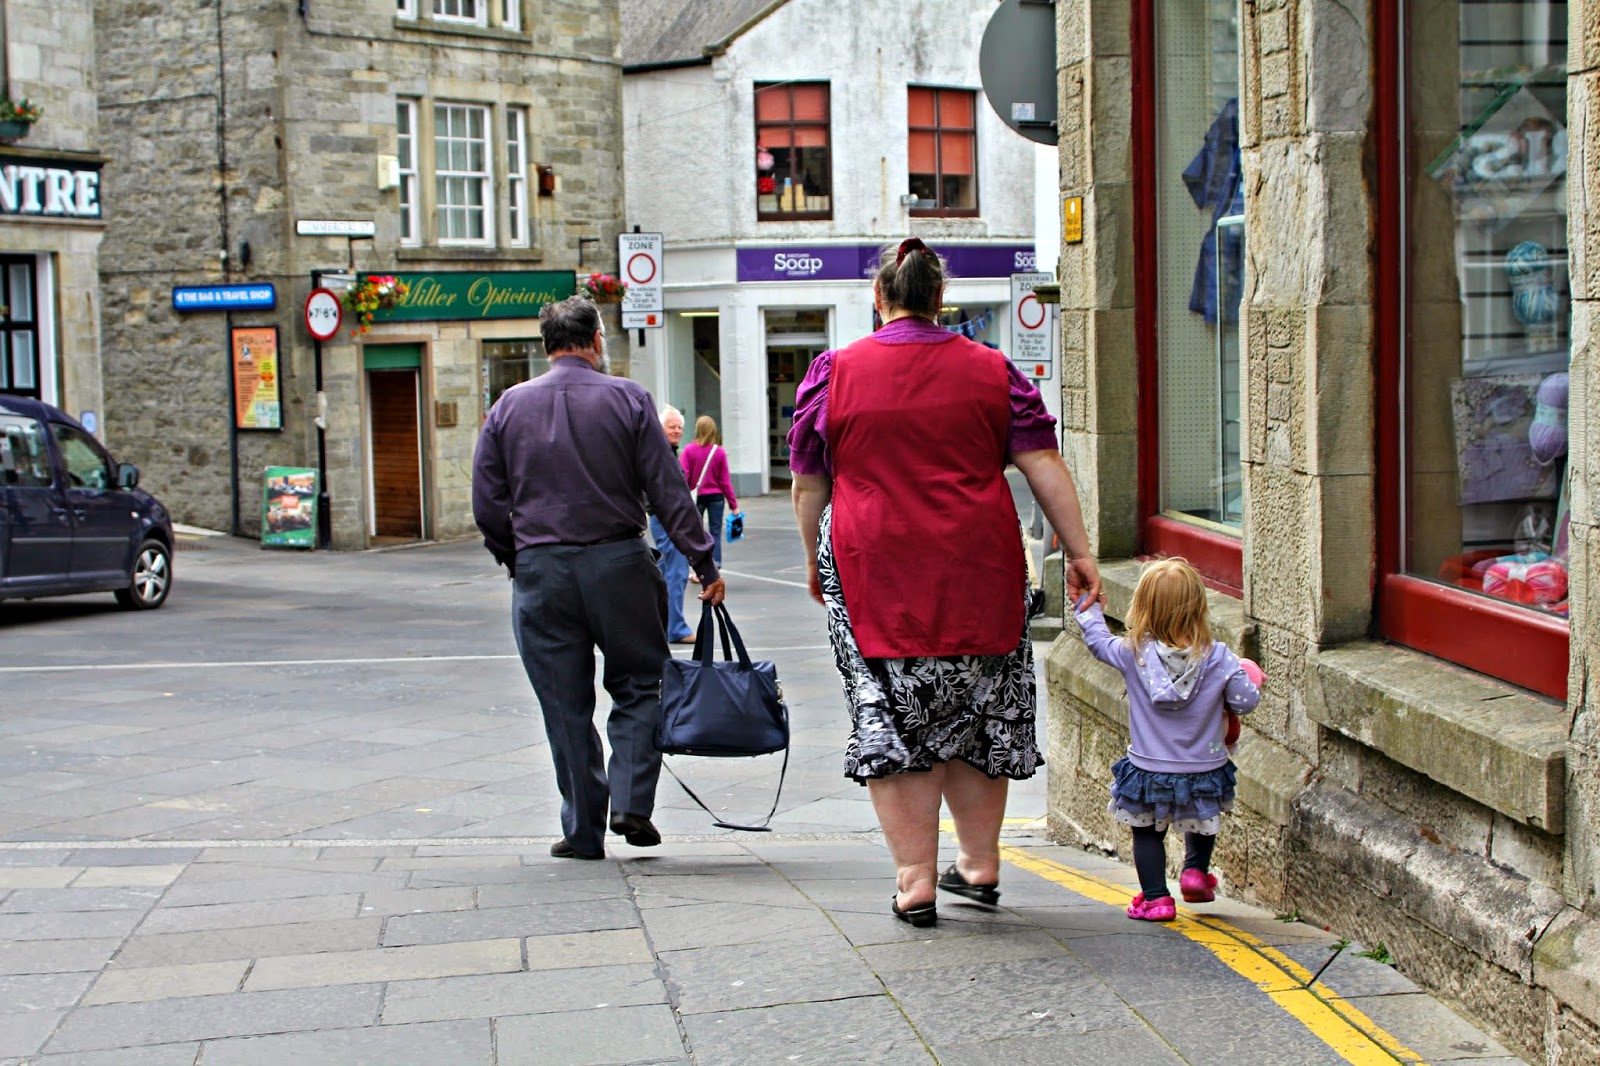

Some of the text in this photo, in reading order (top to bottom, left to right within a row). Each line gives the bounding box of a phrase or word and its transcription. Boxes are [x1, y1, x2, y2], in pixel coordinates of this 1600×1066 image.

[628, 242, 654, 250] ZONE
[774, 253, 823, 275] Soap
[183, 292, 197, 302] THE
[198, 291, 214, 301] BAG
[222, 290, 248, 301] TRAVEL
[249, 289, 271, 299] SHOP
[467, 277, 557, 317] Opticians
